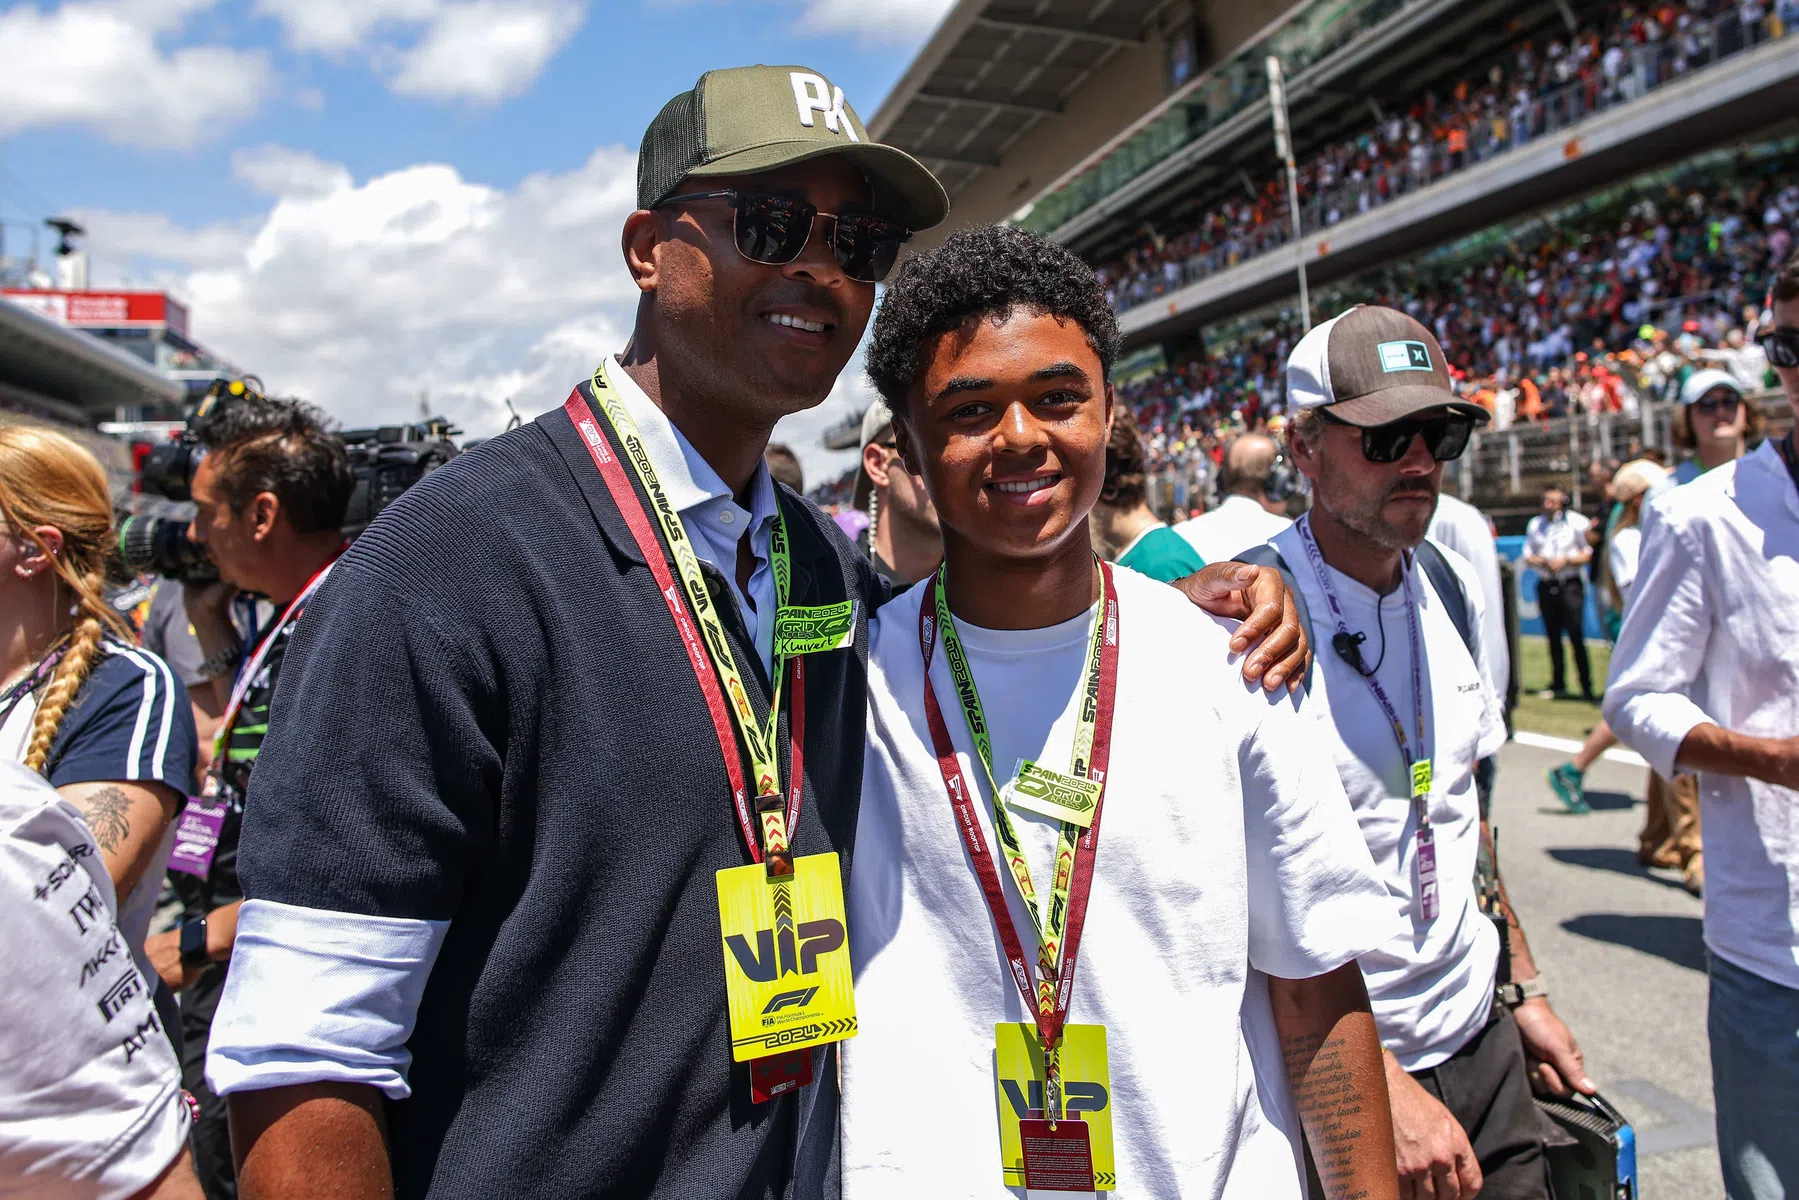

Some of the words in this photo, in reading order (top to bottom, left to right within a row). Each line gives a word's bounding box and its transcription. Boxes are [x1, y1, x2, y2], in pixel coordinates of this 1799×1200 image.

[790, 72, 860, 142] PK
[625, 434, 683, 541] SPAIN2024
[781, 631, 814, 639] ACCESS
[782, 621, 815, 632] GRID
[680, 617, 694, 642] CIRCUIT
[691, 640, 706, 671] ROOFTOP
[945, 635, 984, 735] SPAIN2024
[1024, 763, 1097, 794] SPAIN2024
[1074, 758, 1087, 777] IP
[1050, 795, 1080, 810] ACCESS
[1053, 786, 1083, 803] GRID
[960, 804, 971, 826] CIRCUIT
[968, 826, 980, 853] ROOFTOP
[724, 918, 845, 983] VIP
[765, 1025, 817, 1048] 2024
